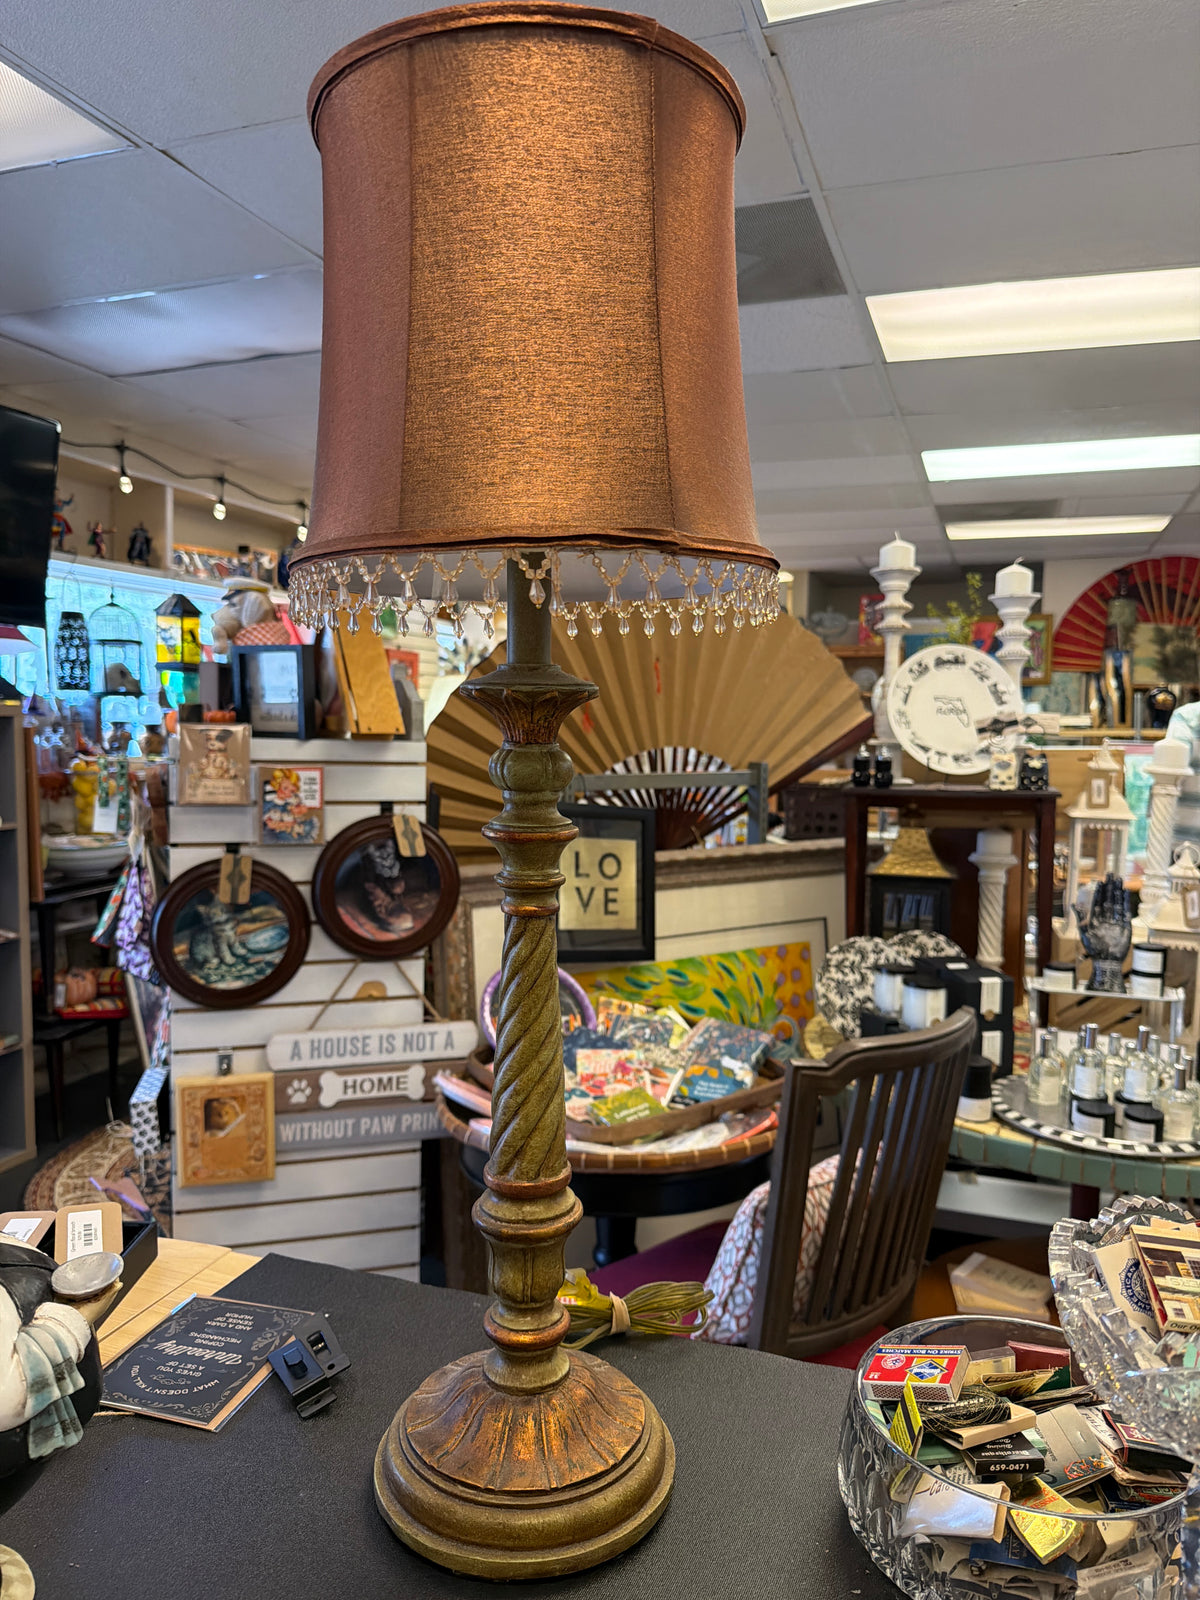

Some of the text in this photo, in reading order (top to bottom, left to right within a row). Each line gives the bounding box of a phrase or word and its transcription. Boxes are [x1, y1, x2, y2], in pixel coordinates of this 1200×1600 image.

[290, 1030, 455, 1061] A HOUSE IS NOT A
[342, 1074, 408, 1095] HOME
[279, 1119, 356, 1143] WITHOUT
[360, 1115, 395, 1136] PAW
[225, 1312, 254, 1320] HUMOR
[206, 1320, 227, 1328] DARK
[188, 1331, 242, 1344] MECHANISMS
[194, 1338, 225, 1347] COPING
[152, 1340, 243, 1365] Unhealthy
[156, 1365, 202, 1377] GIVES YOU
[130, 1365, 219, 1395] WHAT DOESN'T KILL YOU
[990, 1463, 1030, 1472] 659-0471
